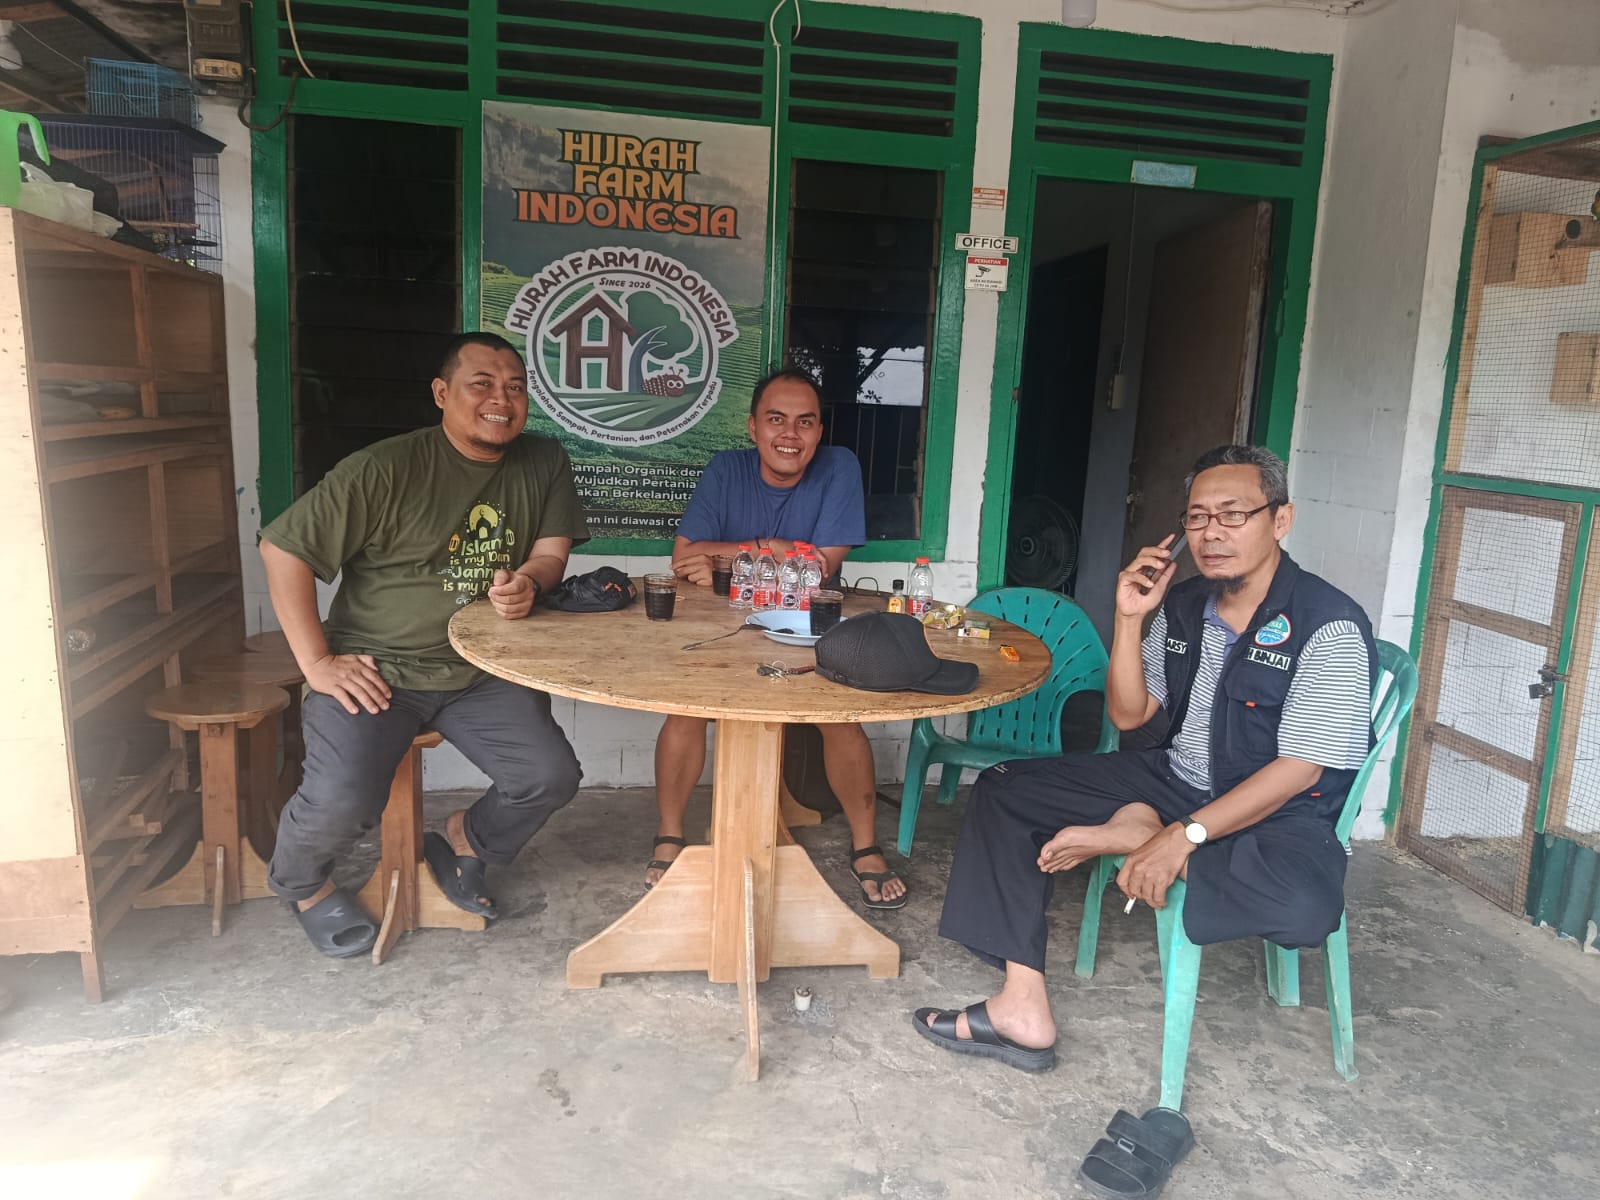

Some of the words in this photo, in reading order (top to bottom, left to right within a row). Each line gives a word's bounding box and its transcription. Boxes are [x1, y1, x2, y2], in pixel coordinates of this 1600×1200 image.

[559, 129, 700, 174] HIJRAH
[572, 164, 686, 202] FARM
[513, 189, 739, 238] INDONESIA
[962, 237, 1011, 249] OFFICE
[628, 281, 651, 289] 2026
[510, 265, 570, 329] HIJRAH
[569, 251, 639, 270] FARM
[644, 255, 735, 343] INDONESIA
[528, 369, 557, 413] Pengolahan
[556, 411, 588, 434] Sampah,
[591, 430, 637, 442] Pertanian,
[656, 411, 700, 438] Peternakan
[696, 381, 717, 410] Terpadu
[624, 465, 677, 478] Organik
[642, 479, 697, 489] Pertania
[604, 515, 618, 524] ini
[621, 515, 664, 526] diawasi
[450, 555, 460, 565] is
[464, 555, 485, 567] my
[443, 579, 454, 591] is
[458, 581, 478, 595] my
[1254, 650, 1289, 669] BINJAI
